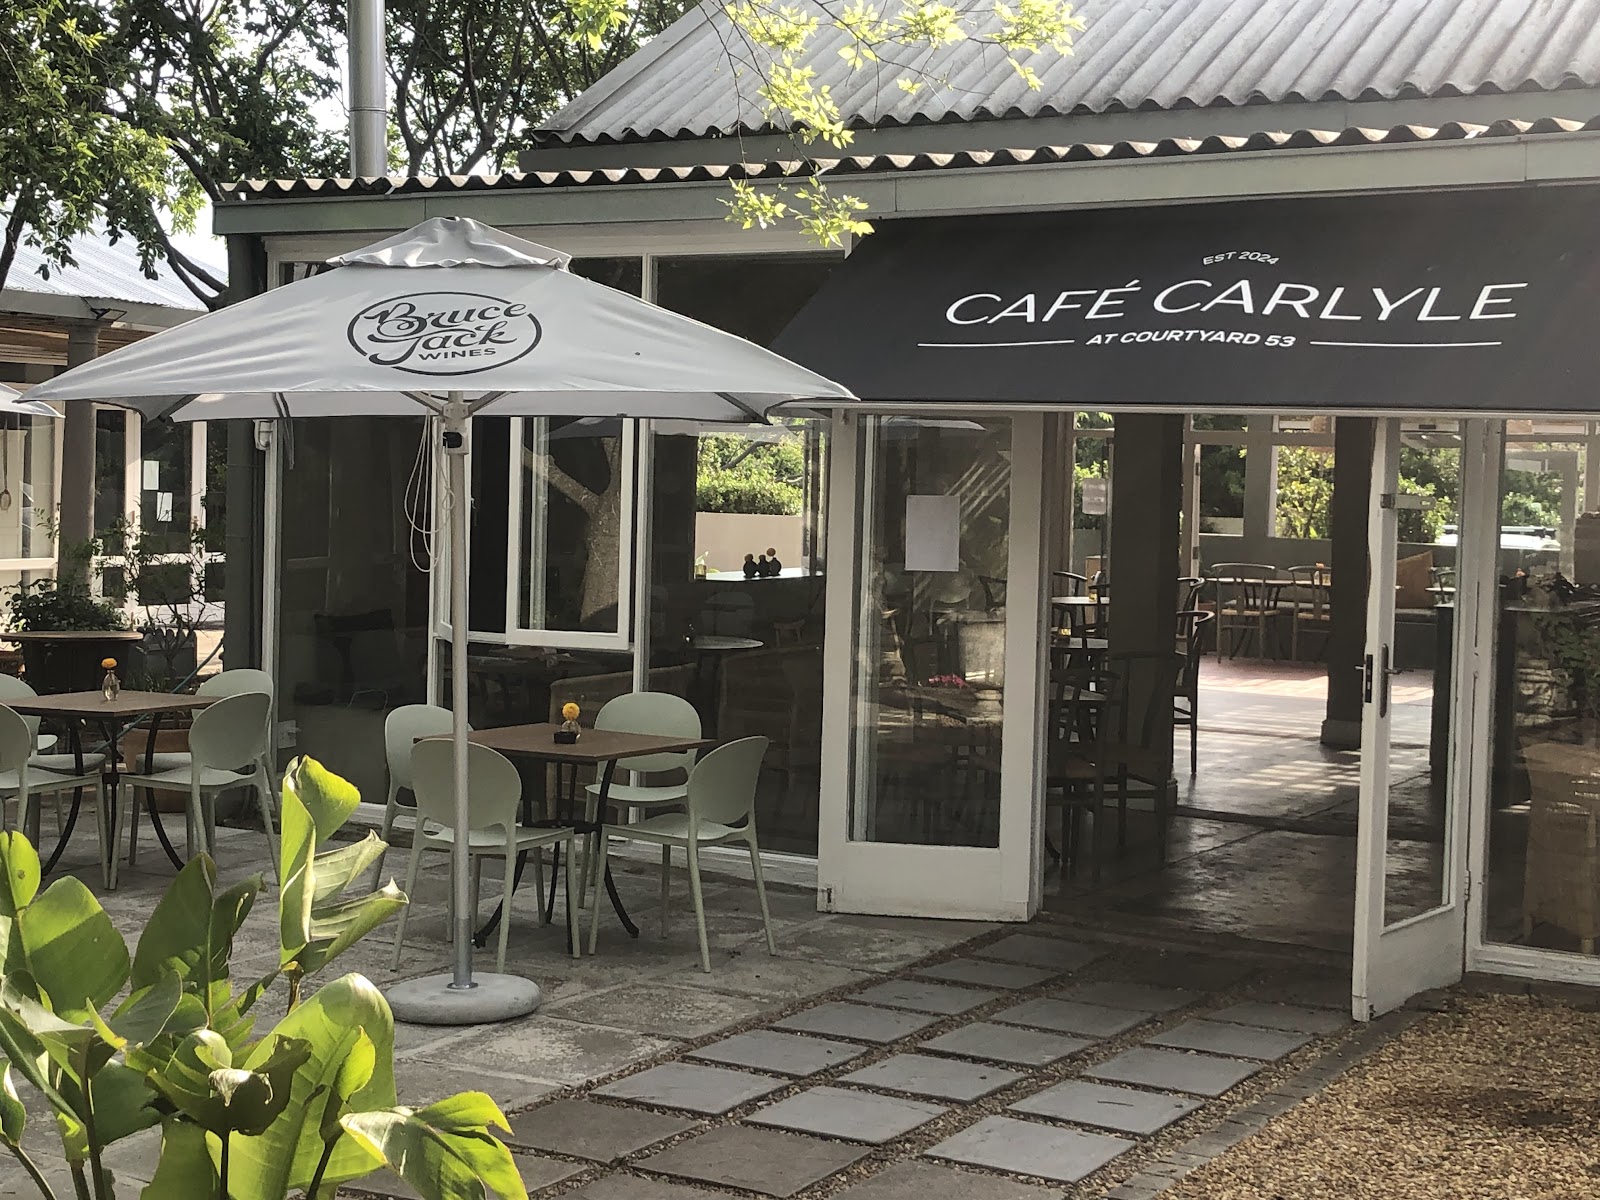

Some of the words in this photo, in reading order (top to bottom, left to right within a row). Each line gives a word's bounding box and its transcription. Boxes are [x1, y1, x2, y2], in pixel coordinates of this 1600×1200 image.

[1202, 251, 1237, 266] EST
[1238, 251, 1280, 265] 2024
[945, 279, 1142, 325] CAFÉ
[1153, 279, 1529, 321] CARLYLE
[363, 302, 527, 338] Bruce
[367, 320, 518, 366] Jack
[1085, 332, 1119, 346] AT
[1119, 329, 1261, 345] COURTYARD
[1264, 334, 1297, 348] 53
[418, 347, 497, 361] WINES
